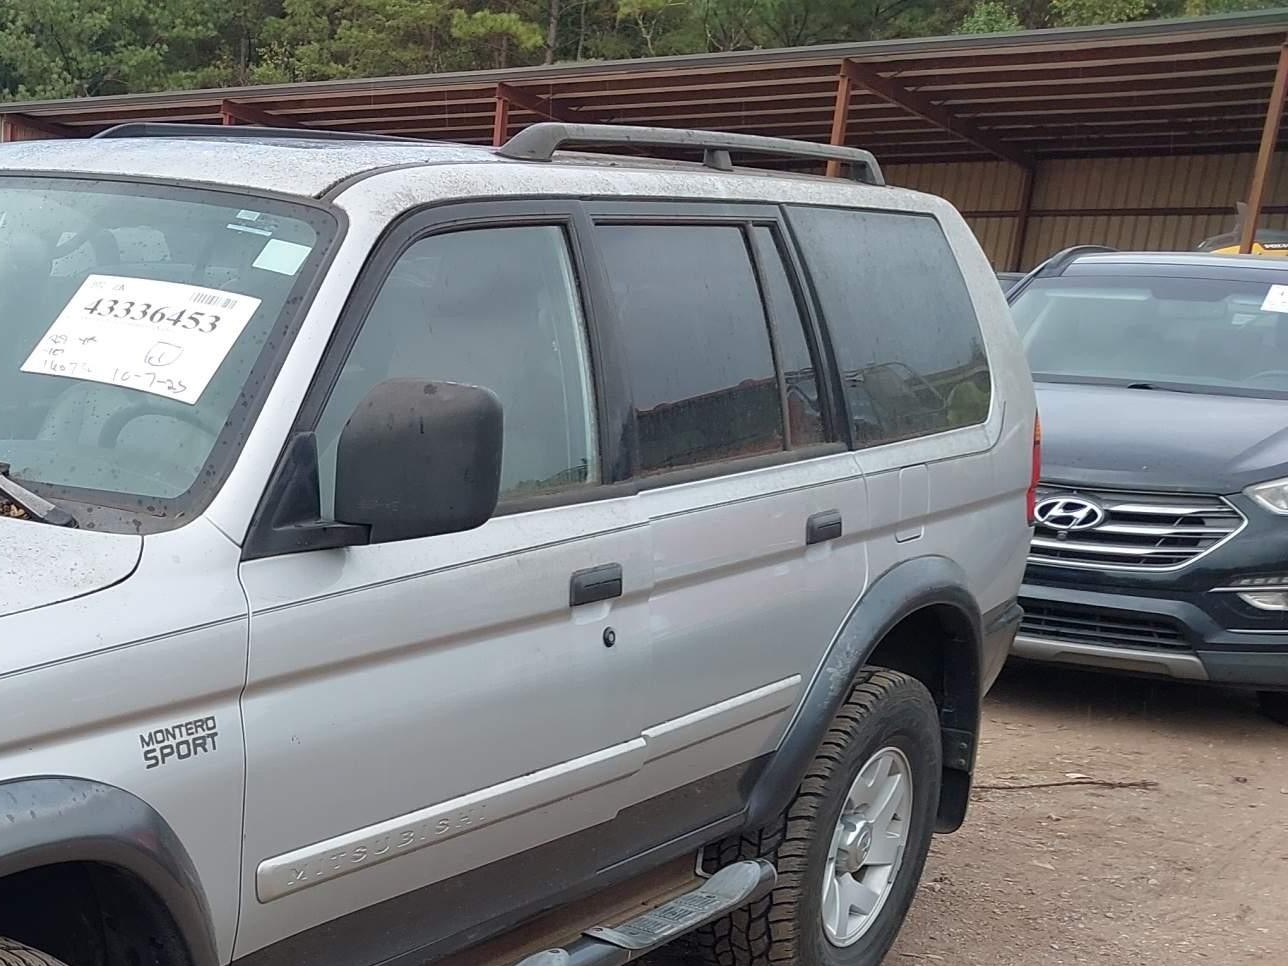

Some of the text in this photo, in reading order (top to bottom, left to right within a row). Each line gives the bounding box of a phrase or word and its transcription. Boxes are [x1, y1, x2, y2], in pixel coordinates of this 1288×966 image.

[84, 298, 221, 333] 43336453
[139, 716, 217, 748] MONTERO
[143, 732, 218, 769] SPORT
[286, 803, 489, 887] MITSUBISHI
